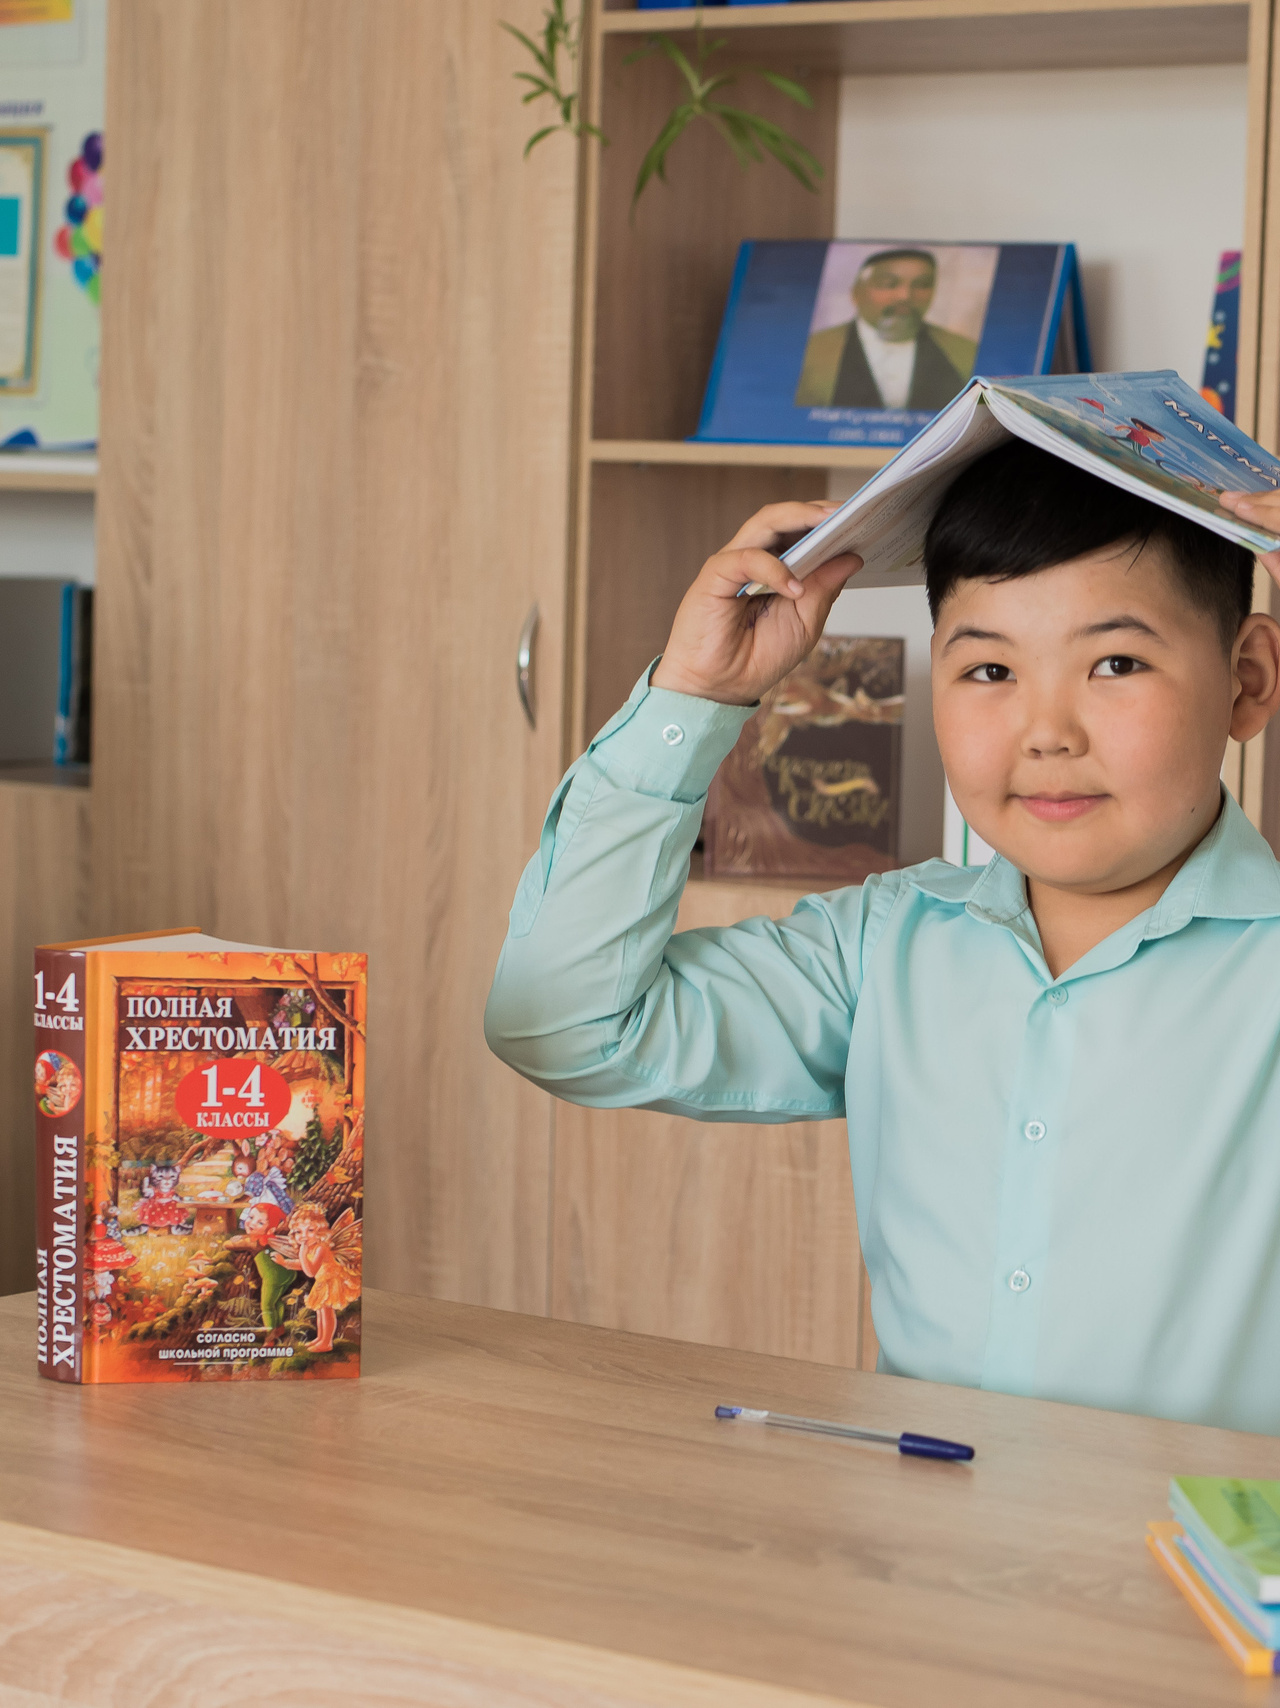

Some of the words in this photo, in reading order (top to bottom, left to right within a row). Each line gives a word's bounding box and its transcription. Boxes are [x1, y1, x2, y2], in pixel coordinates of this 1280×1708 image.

[1162, 398, 1280, 488] МАТЕМА
[34, 970, 80, 1012] 1-4
[126, 996, 233, 1018] ПОЛНАЯ
[125, 1026, 337, 1051] ХРЕСТОМАТИЯ
[200, 1064, 265, 1107] 1-4
[196, 1112, 270, 1128] КЛАССЫ
[53, 1134, 78, 1369] ХРЕСТОМАТИЯ
[196, 1332, 256, 1344] согласно
[158, 1346, 220, 1360] школьной
[223, 1345, 294, 1360] программе
